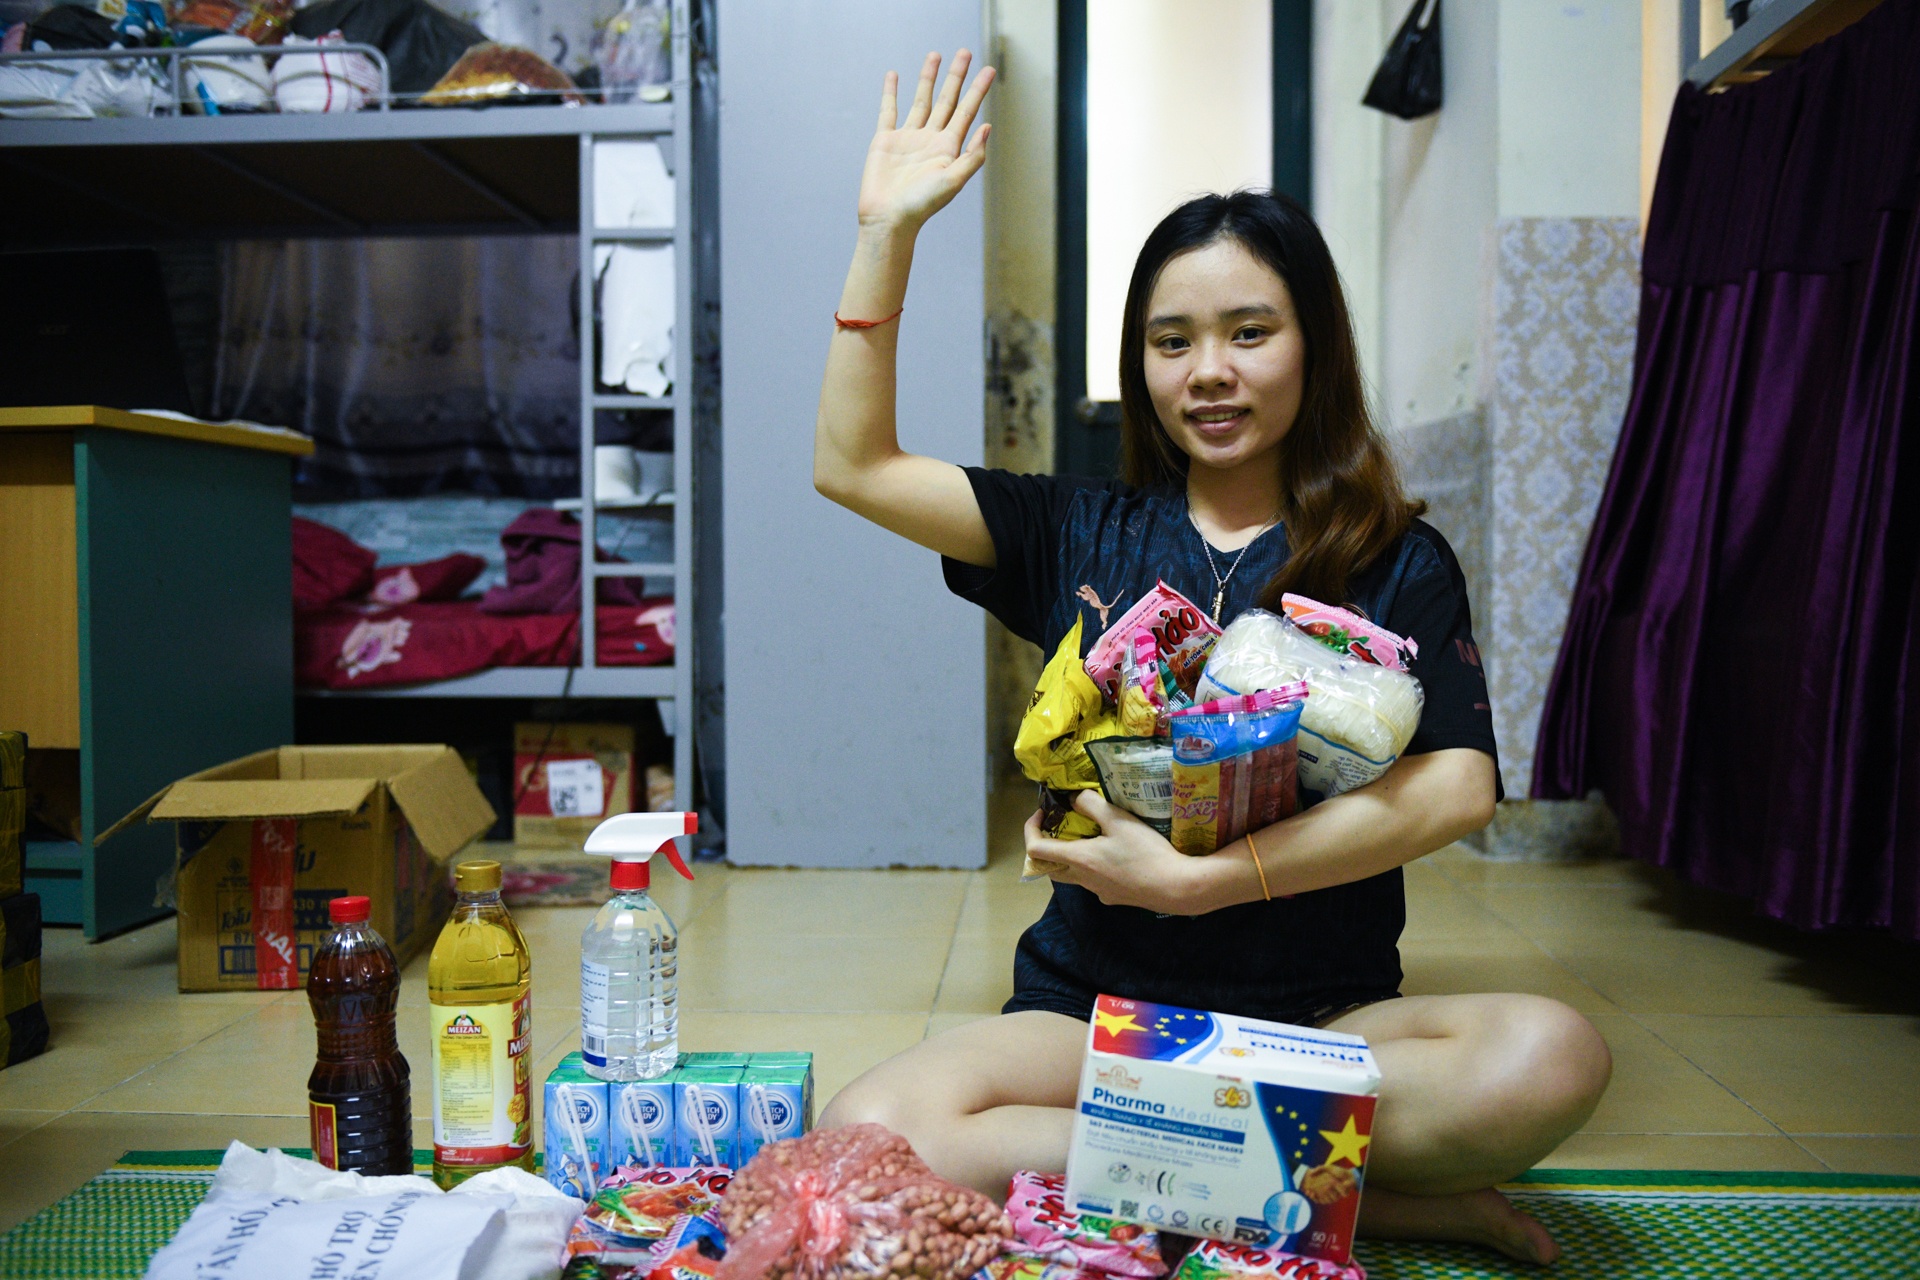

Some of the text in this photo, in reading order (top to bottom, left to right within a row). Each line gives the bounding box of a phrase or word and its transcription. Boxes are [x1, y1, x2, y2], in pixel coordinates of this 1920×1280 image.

[1200, 637, 1216, 650] CHUA
[448, 1026, 481, 1034] MEIZAN
[1214, 1086, 1252, 1108] S63
[1093, 1086, 1249, 1130] Pharma Medical
[1104, 1122, 1159, 1140] ANTIBACTERIAL
[1162, 1135, 1194, 1146] MEDICAL
[1233, 1227, 1269, 1244] FDA
